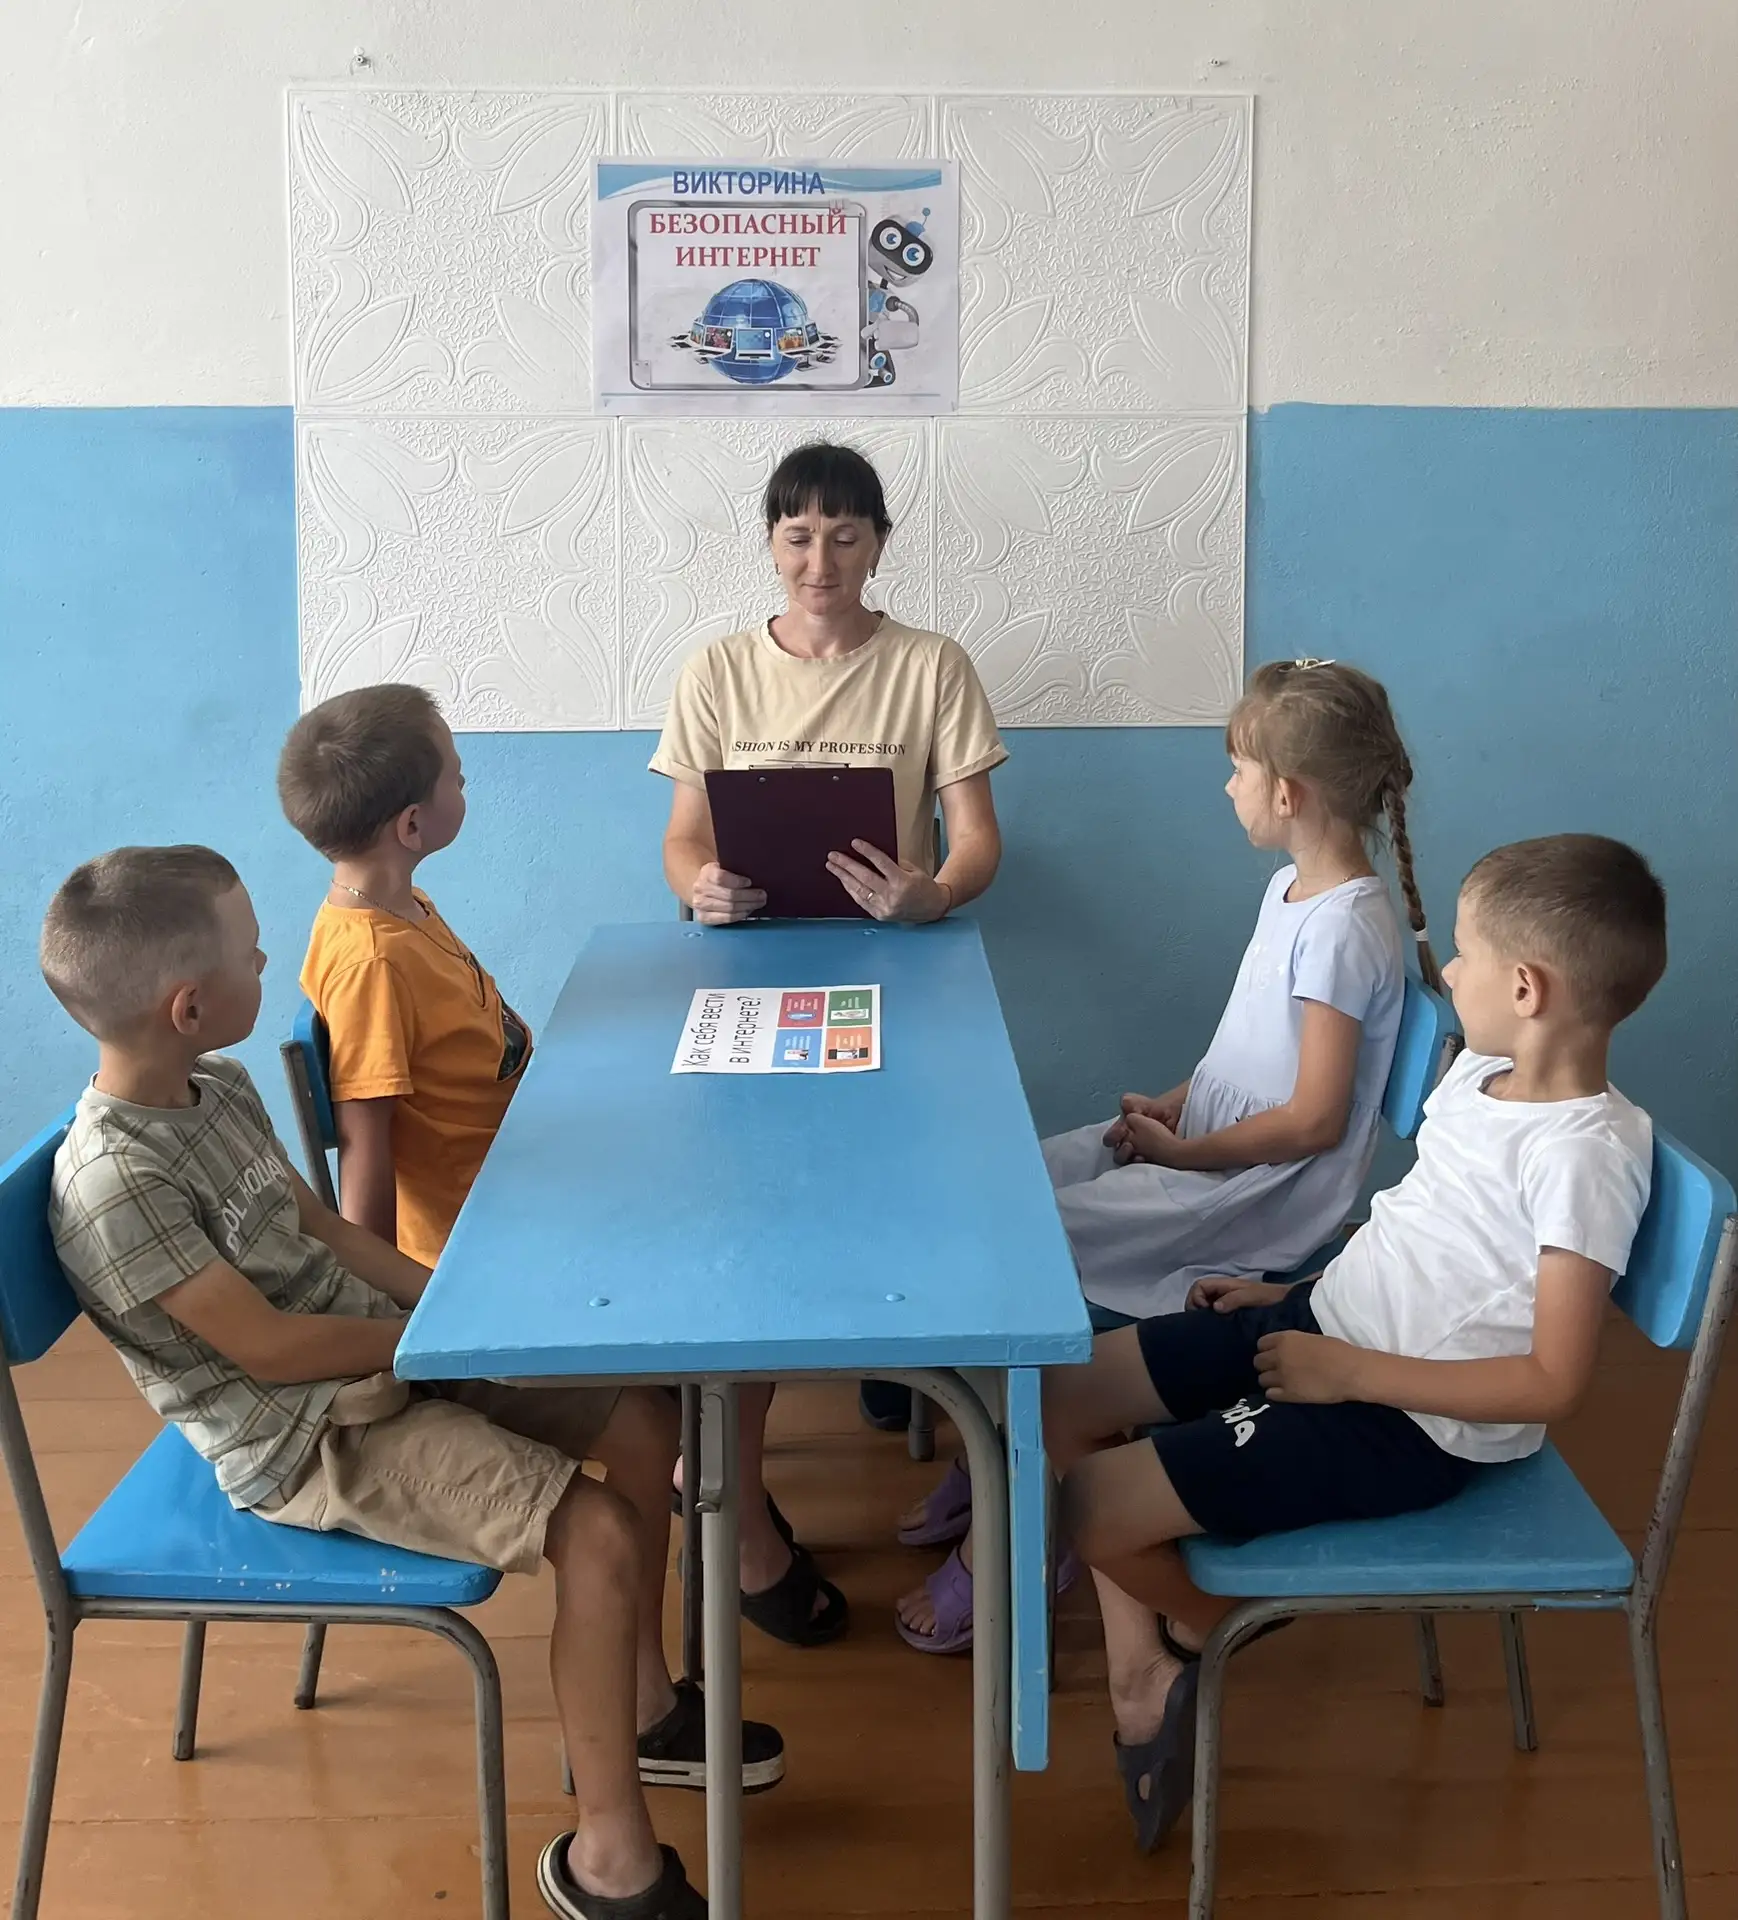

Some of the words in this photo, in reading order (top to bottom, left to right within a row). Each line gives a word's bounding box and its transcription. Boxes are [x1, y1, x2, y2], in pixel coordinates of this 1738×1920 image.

[672, 171, 826, 195] ВИКТОРИНА
[649, 207, 847, 235] БЕЗОПАСНЫЙ
[675, 246, 821, 267] ИНТЕРНЕТ
[731, 740, 776, 752] SHION
[777, 740, 790, 751] IS
[793, 741, 815, 752] MY
[819, 741, 906, 756] PROFESSION
[701, 993, 726, 1020] вести
[690, 1021, 716, 1045] себя
[731, 996, 764, 1054] интернете?
[681, 1047, 712, 1067] Как
[729, 1056, 750, 1064] в
